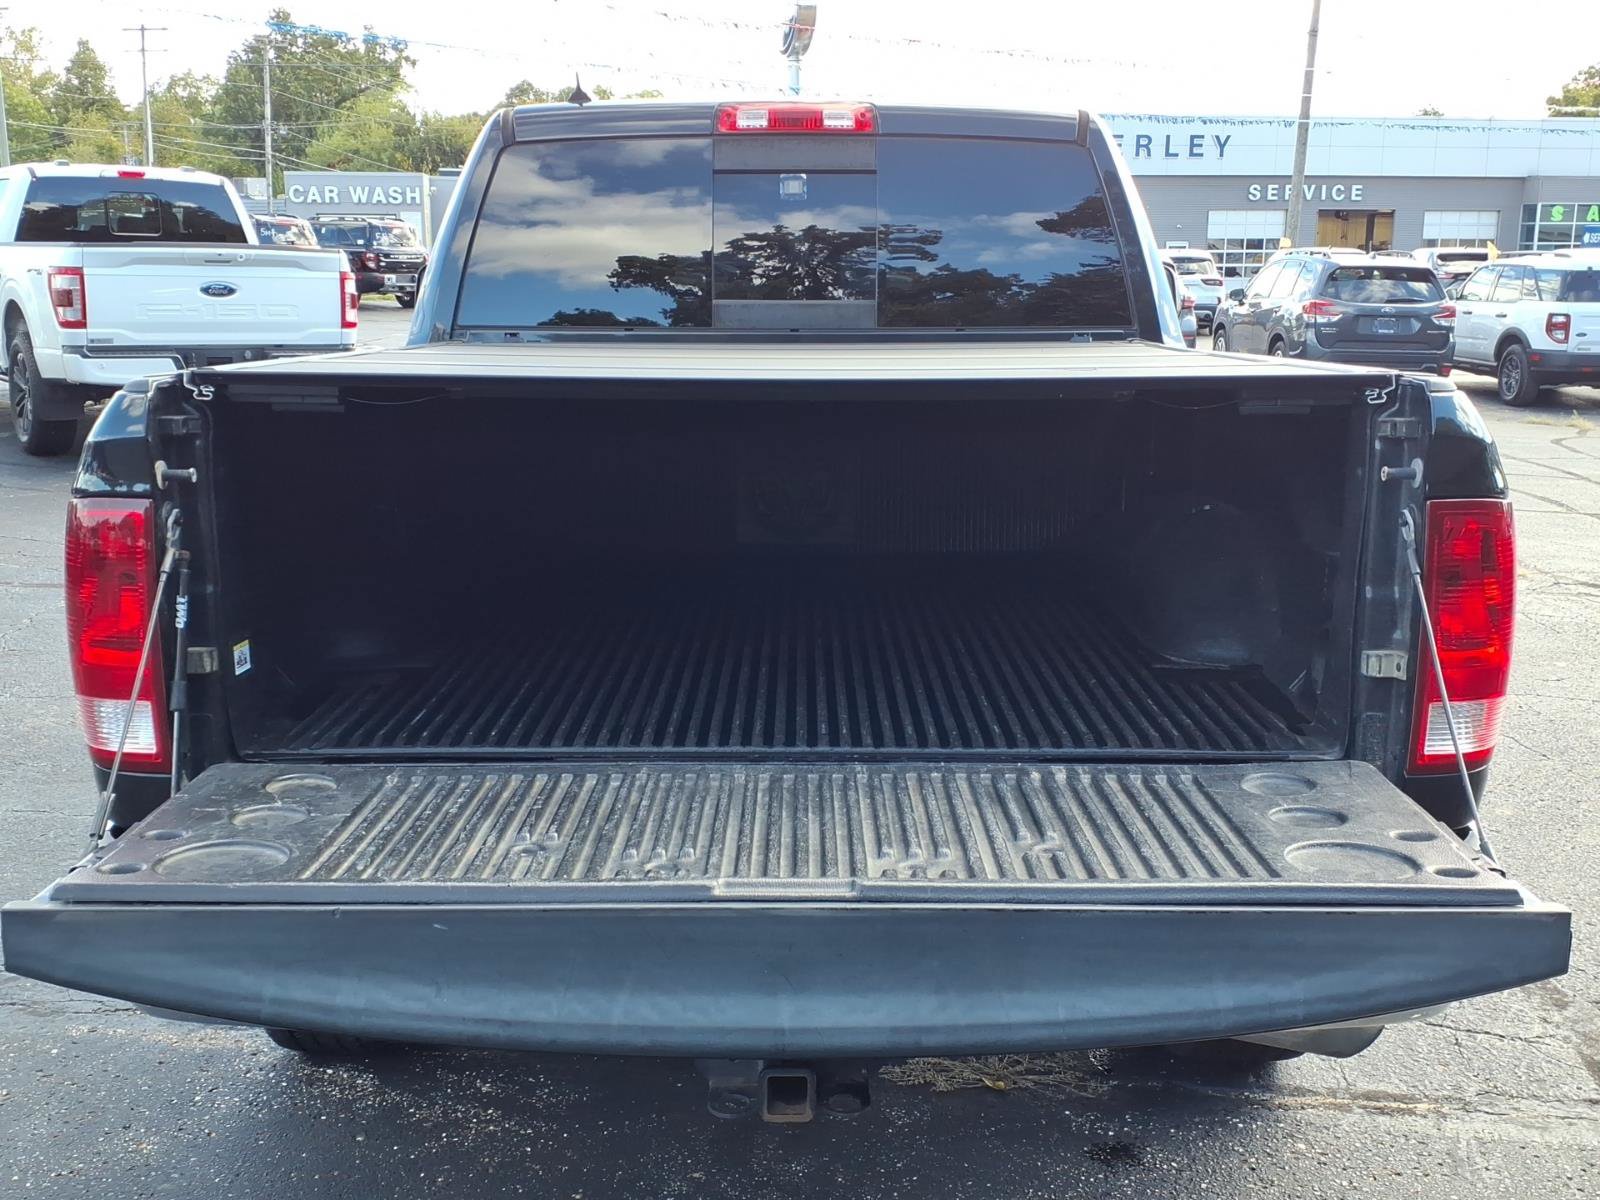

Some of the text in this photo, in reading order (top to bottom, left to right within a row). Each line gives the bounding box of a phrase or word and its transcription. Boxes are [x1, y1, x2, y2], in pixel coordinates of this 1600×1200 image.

[288, 185, 421, 205] CAR WASH
[1248, 184, 1364, 201] SERVICE
[136, 303, 300, 320] F-150
